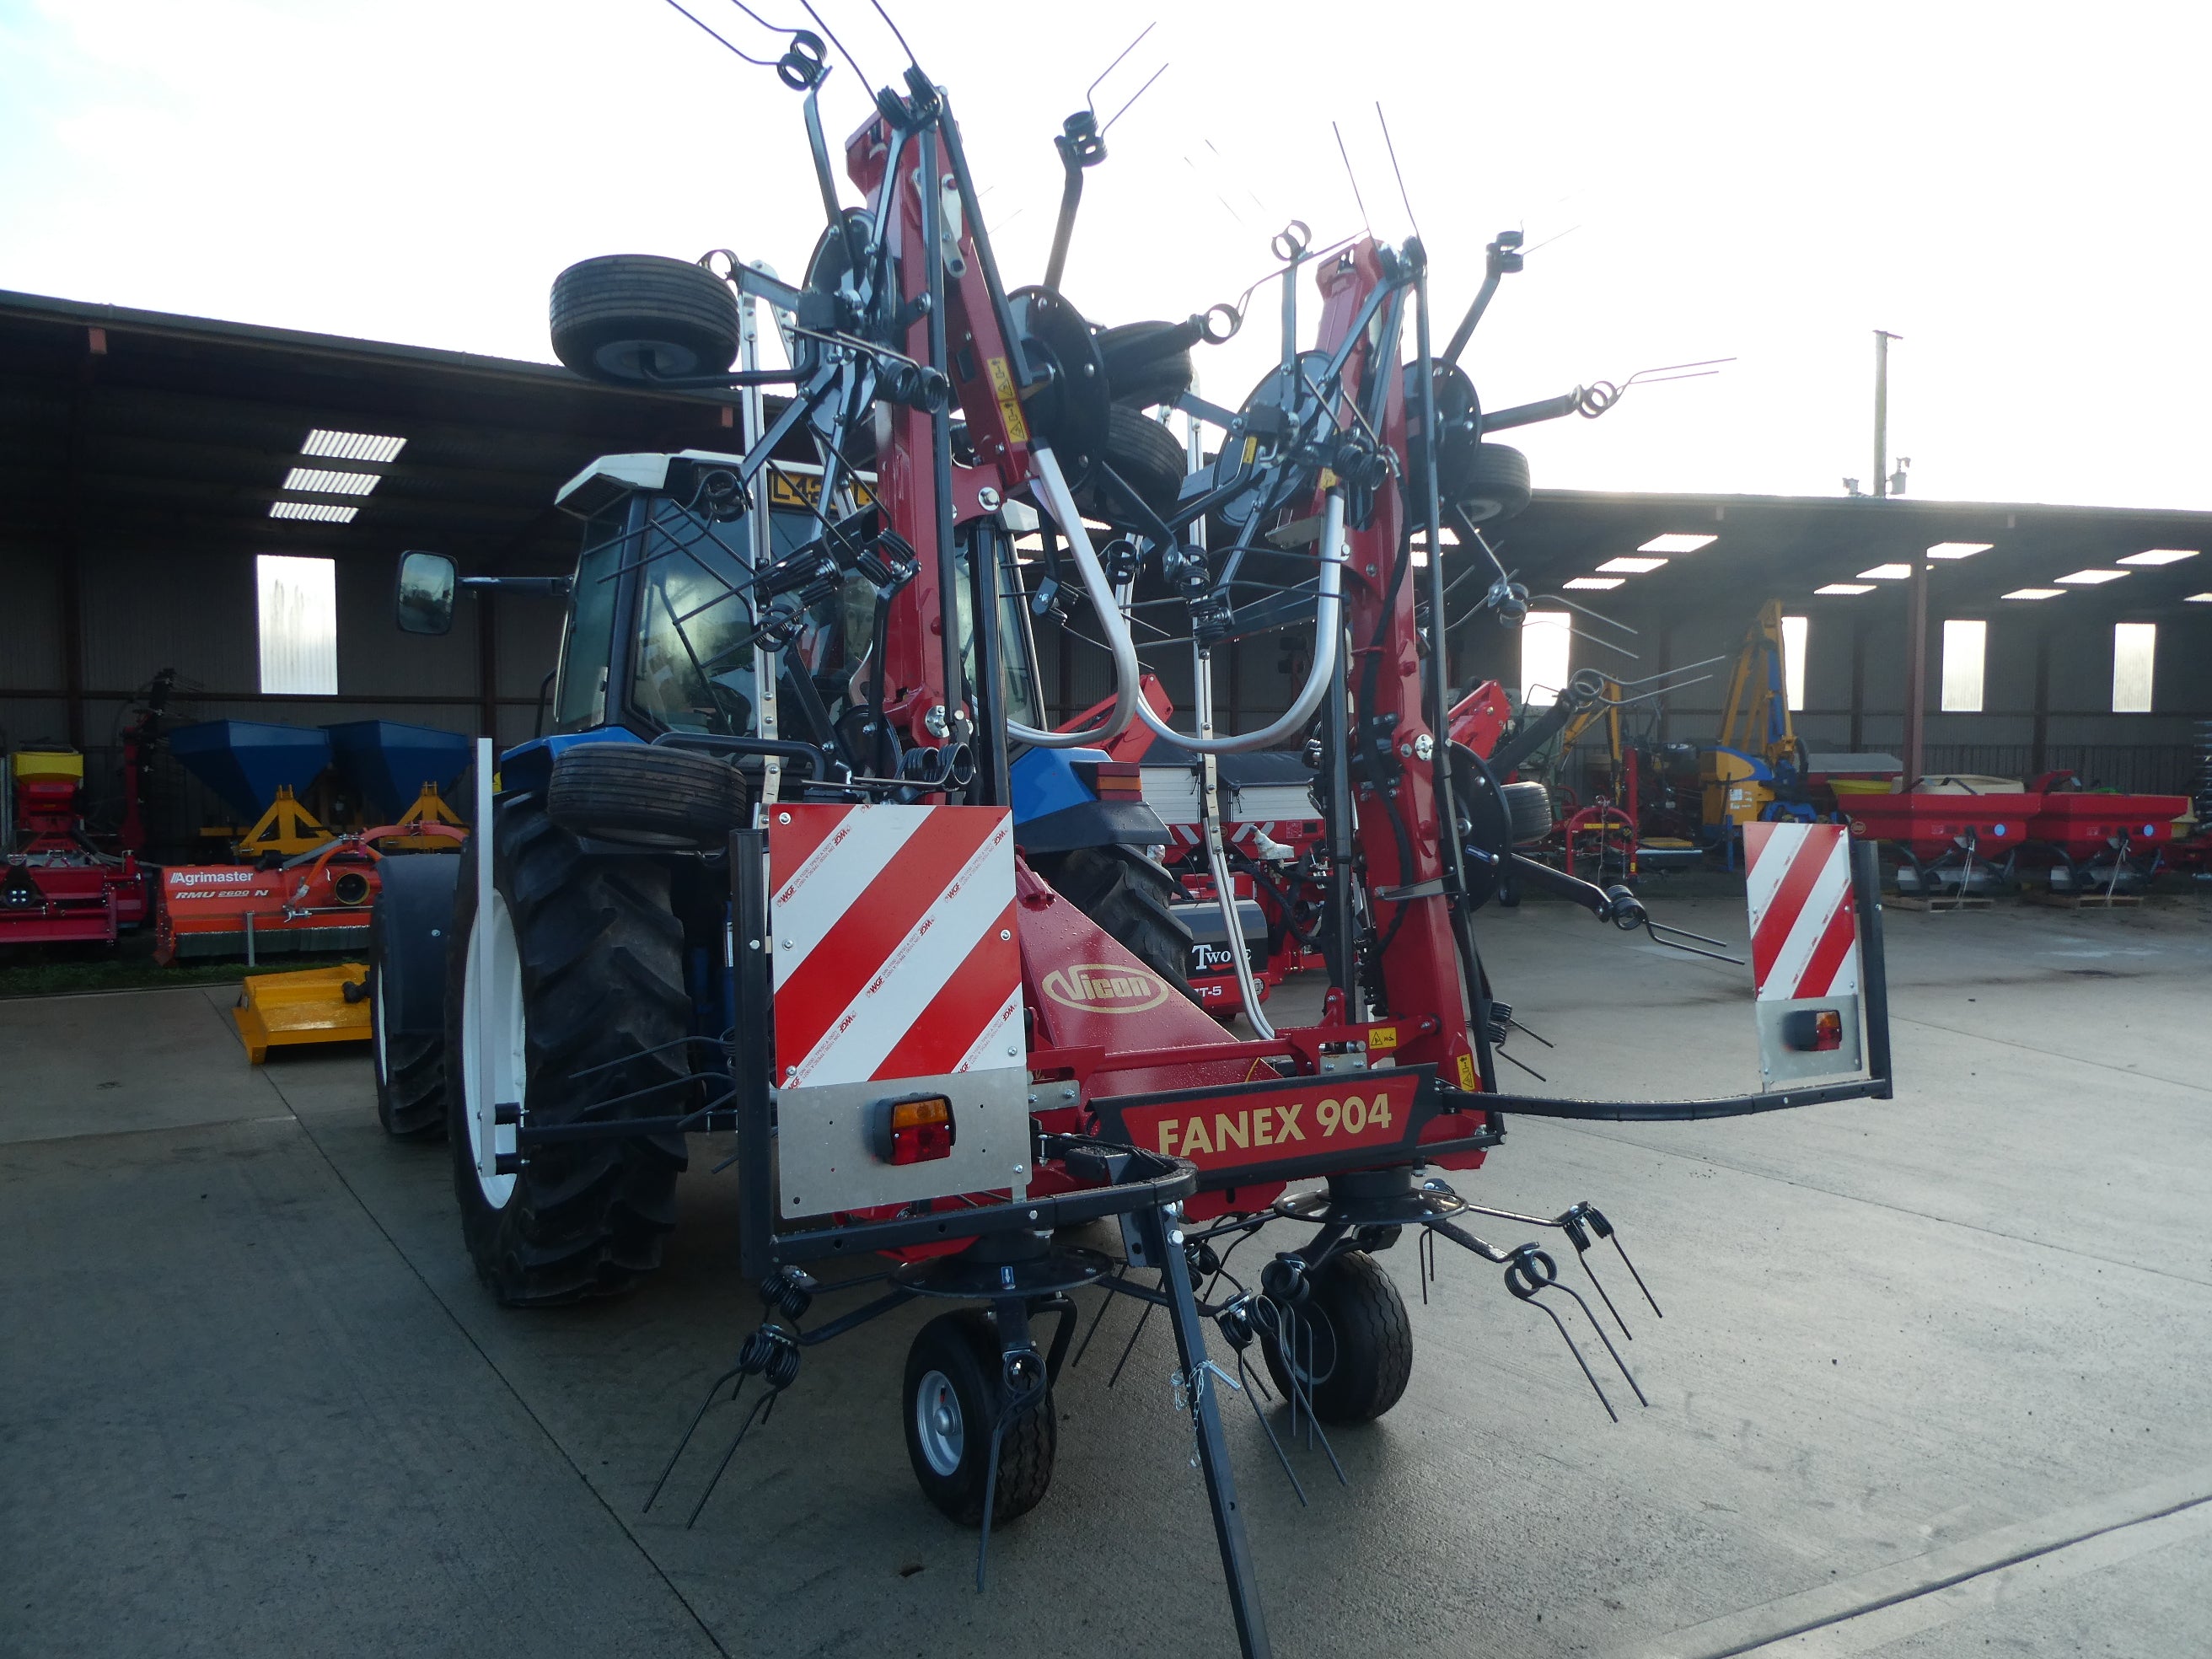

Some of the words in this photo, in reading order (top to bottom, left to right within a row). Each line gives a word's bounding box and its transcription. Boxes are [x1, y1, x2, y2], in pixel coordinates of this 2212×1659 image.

[171, 872, 254, 885] Agrimaster
[780, 885, 796, 903] WGF
[870, 975, 883, 993] WGF
[1050, 967, 1153, 1003] Vicon
[839, 1016, 853, 1034] WGF
[1158, 1103, 1306, 1157] FANEX
[1316, 1093, 1392, 1136] 904
